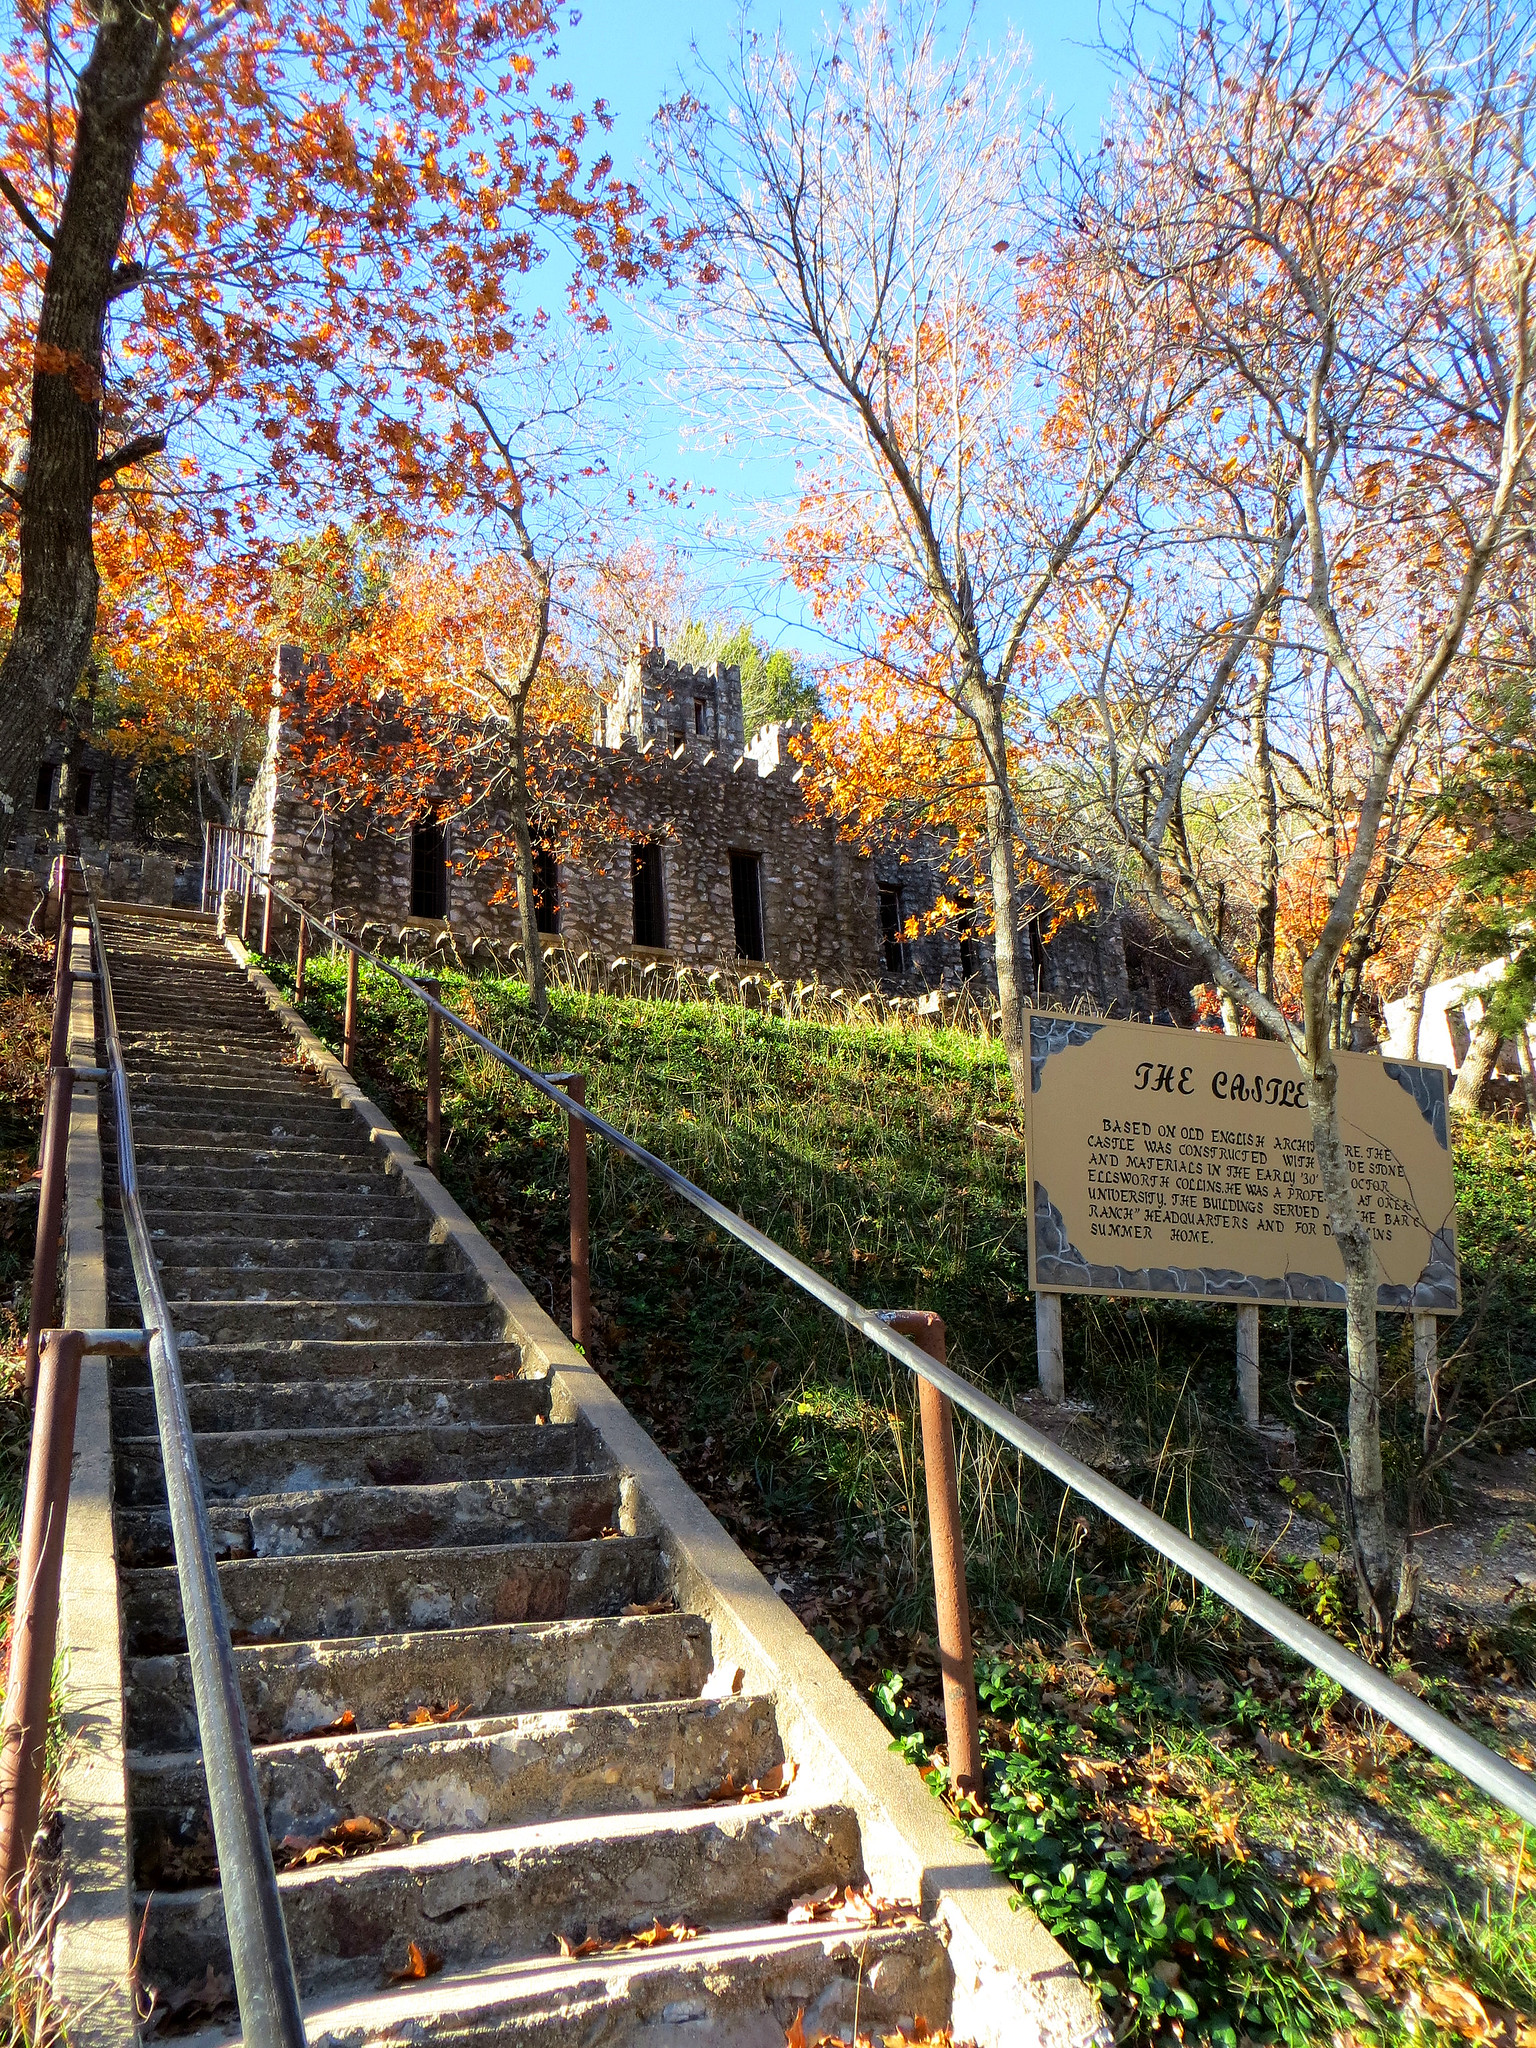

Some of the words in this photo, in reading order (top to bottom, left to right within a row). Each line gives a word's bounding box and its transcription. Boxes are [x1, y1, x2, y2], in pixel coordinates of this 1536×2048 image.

[1134, 1062, 1195, 1095] THE
[1211, 1071, 1308, 1109] CASTLE
[1087, 1135, 1135, 1152] CASTLE
[1144, 1140, 1172, 1155] WAS
[1179, 1144, 1268, 1165] CONSTRUCTED
[1283, 1154, 1315, 1169] WITH
[1368, 1162, 1405, 1178] STONE
[1103, 1119, 1151, 1136] BASED
[1157, 1125, 1176, 1138] ON
[1180, 1127, 1204, 1141] OLD
[1211, 1130, 1265, 1148] ENGLISH
[1365, 1147, 1392, 1162] THE
[1088, 1153, 1119, 1167] AND
[1126, 1155, 1203, 1175] MATERIALS
[1207, 1163, 1221, 1176] IN
[1226, 1165, 1251, 1180] THE
[1256, 1168, 1296, 1188] EARLY
[1350, 1178, 1389, 1193] OCTOR
[1088, 1169, 1169, 1188] ELLSWORTH
[1245, 1183, 1269, 1198] WAS
[1273, 1187, 1282, 1199] A
[1287, 1187, 1326, 1203] PROFE
[1088, 1187, 1167, 1209] UNIVERSITY.
[1171, 1193, 1198, 1208] THE
[1203, 1196, 1263, 1214] BUILDINGS
[1273, 1203, 1320, 1219] SERVED
[1356, 1210, 1376, 1224] HE
[1384, 1213, 1410, 1226] BAR
[1144, 1209, 1249, 1230] HEADQUARTERS
[1256, 1218, 1285, 1232] AND
[1294, 1222, 1317, 1235] FOR
[1090, 1223, 1152, 1239] SUMMER
[1170, 1228, 1214, 1243] HOME.
